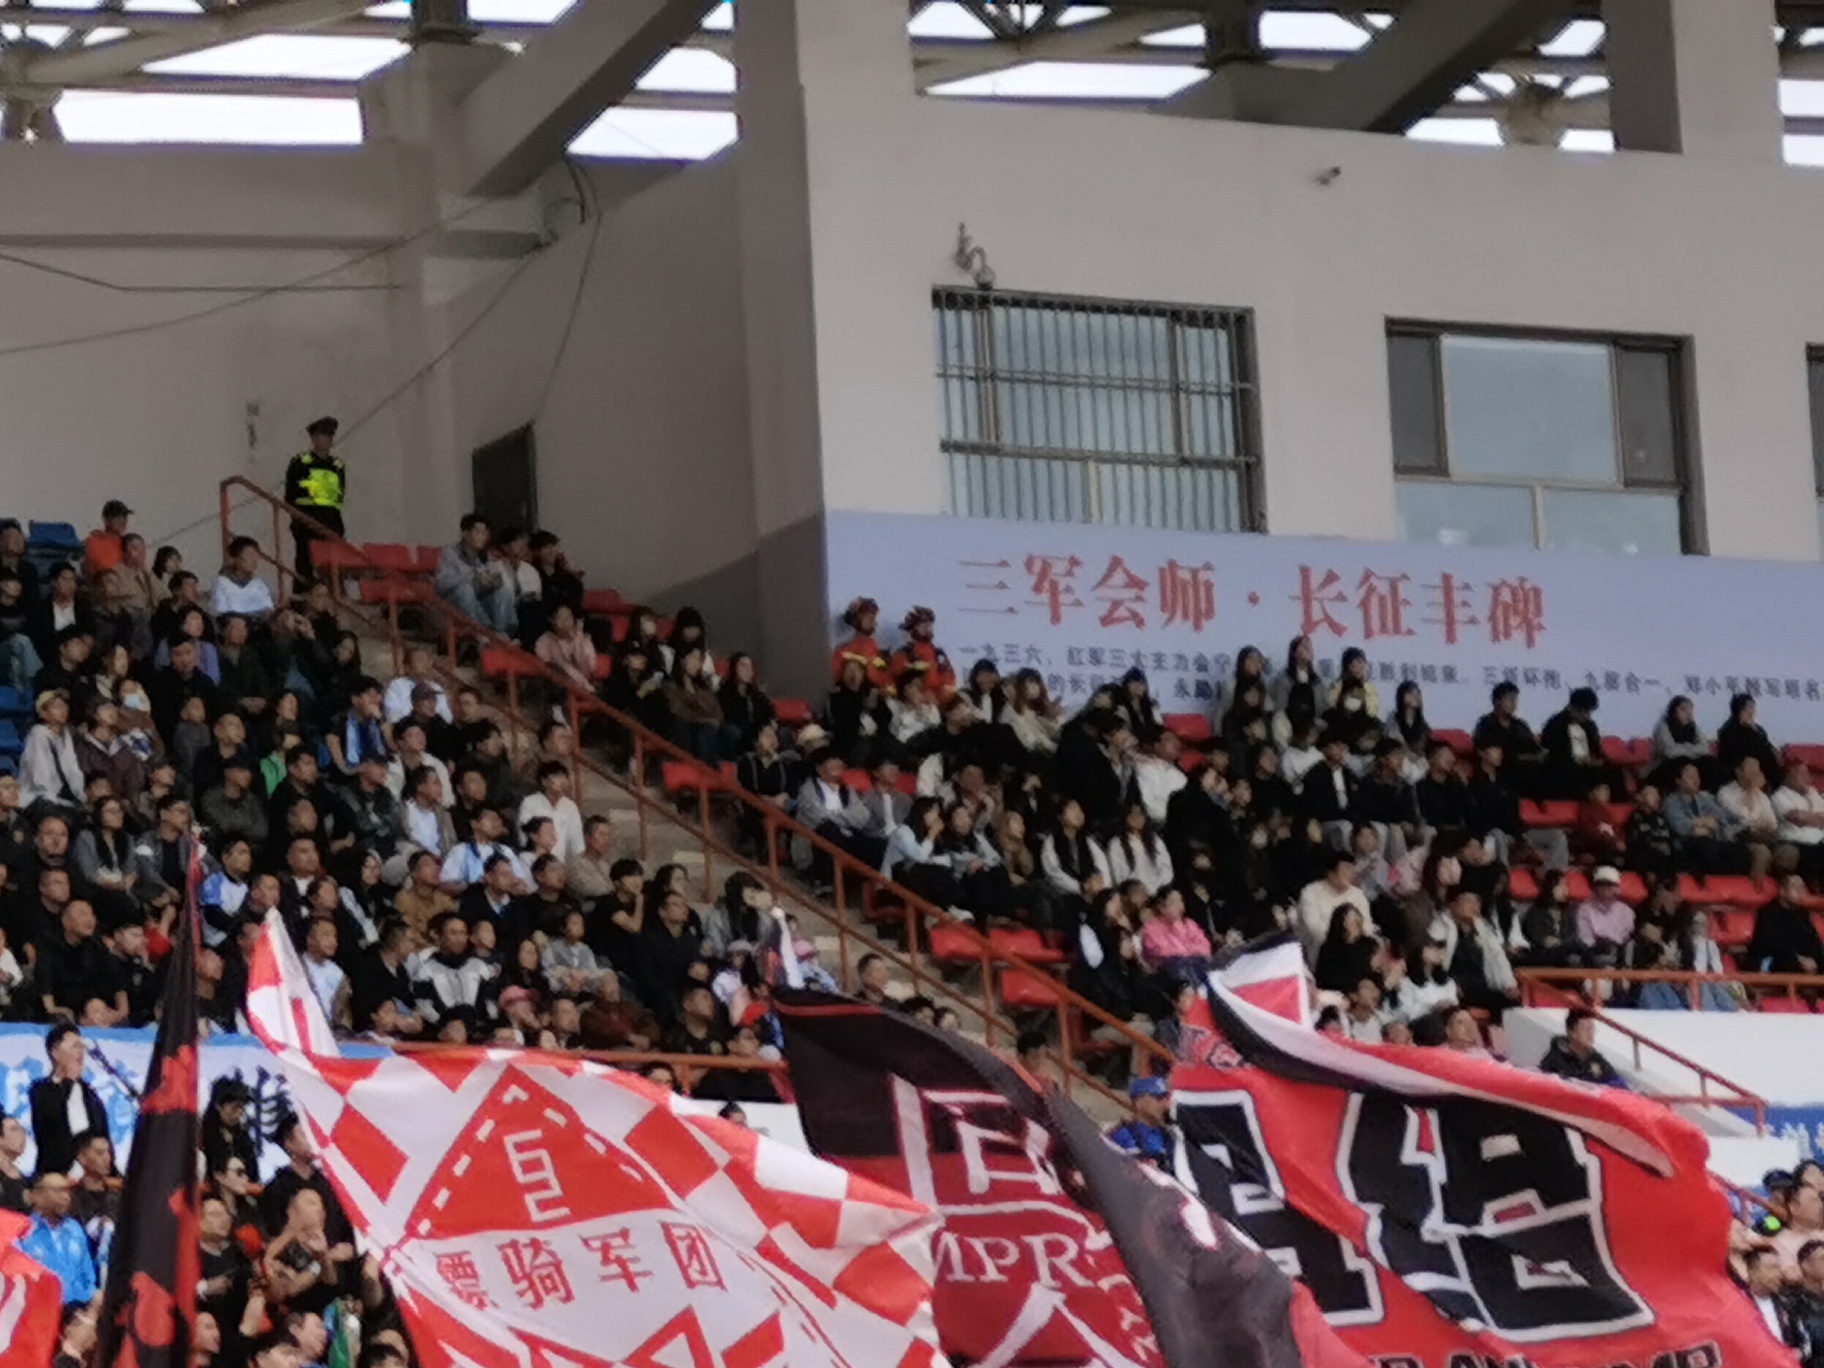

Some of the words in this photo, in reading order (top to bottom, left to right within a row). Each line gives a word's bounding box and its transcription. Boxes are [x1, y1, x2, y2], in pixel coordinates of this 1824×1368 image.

[958, 552, 1547, 650] 三军会师·长征丰碑
